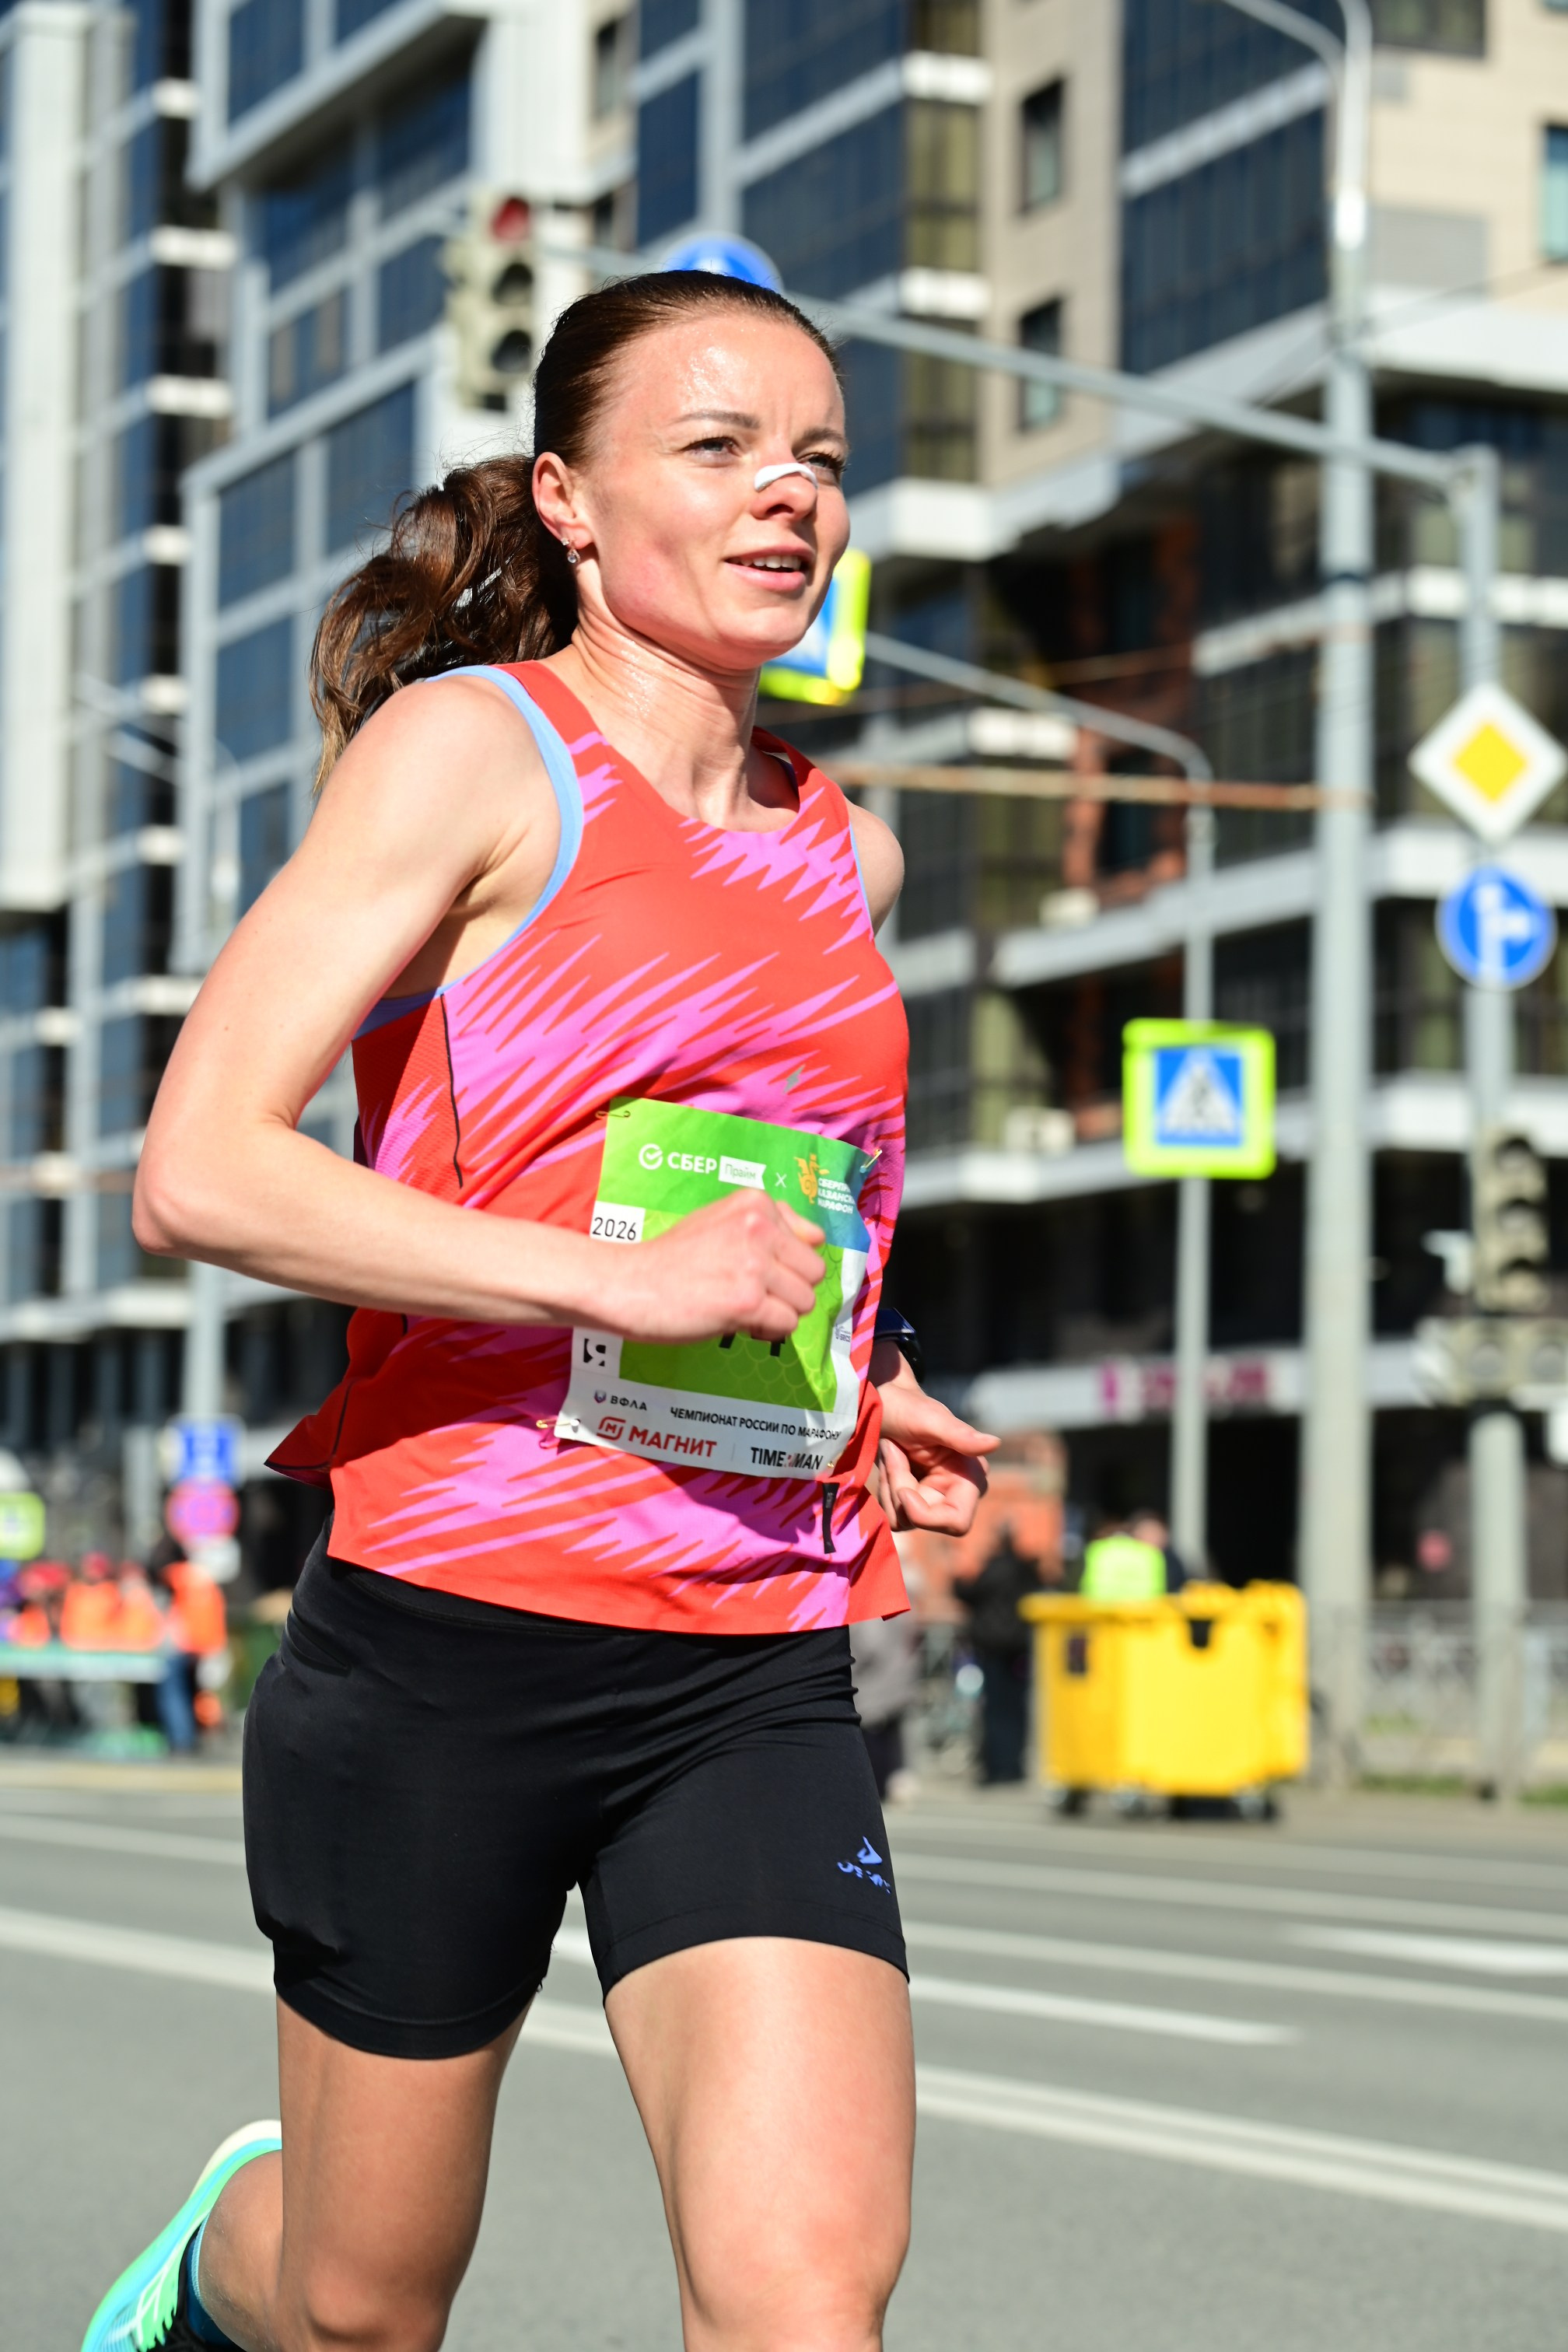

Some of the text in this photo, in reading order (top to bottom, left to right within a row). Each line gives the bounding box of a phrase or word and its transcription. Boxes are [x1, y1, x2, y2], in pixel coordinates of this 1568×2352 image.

[667, 1152, 757, 1181] СБЕР Прайм
[817, 1187, 856, 1205] КАЗАНСК
[592, 1216, 636, 1241] 2026
[610, 1395, 648, 1412] ВФЛА
[670, 1406, 842, 1440] ЧЕМПИОНАТ РОССИИ ПО МАРАФОНУ
[628, 1425, 718, 1458] МАГНИТ
